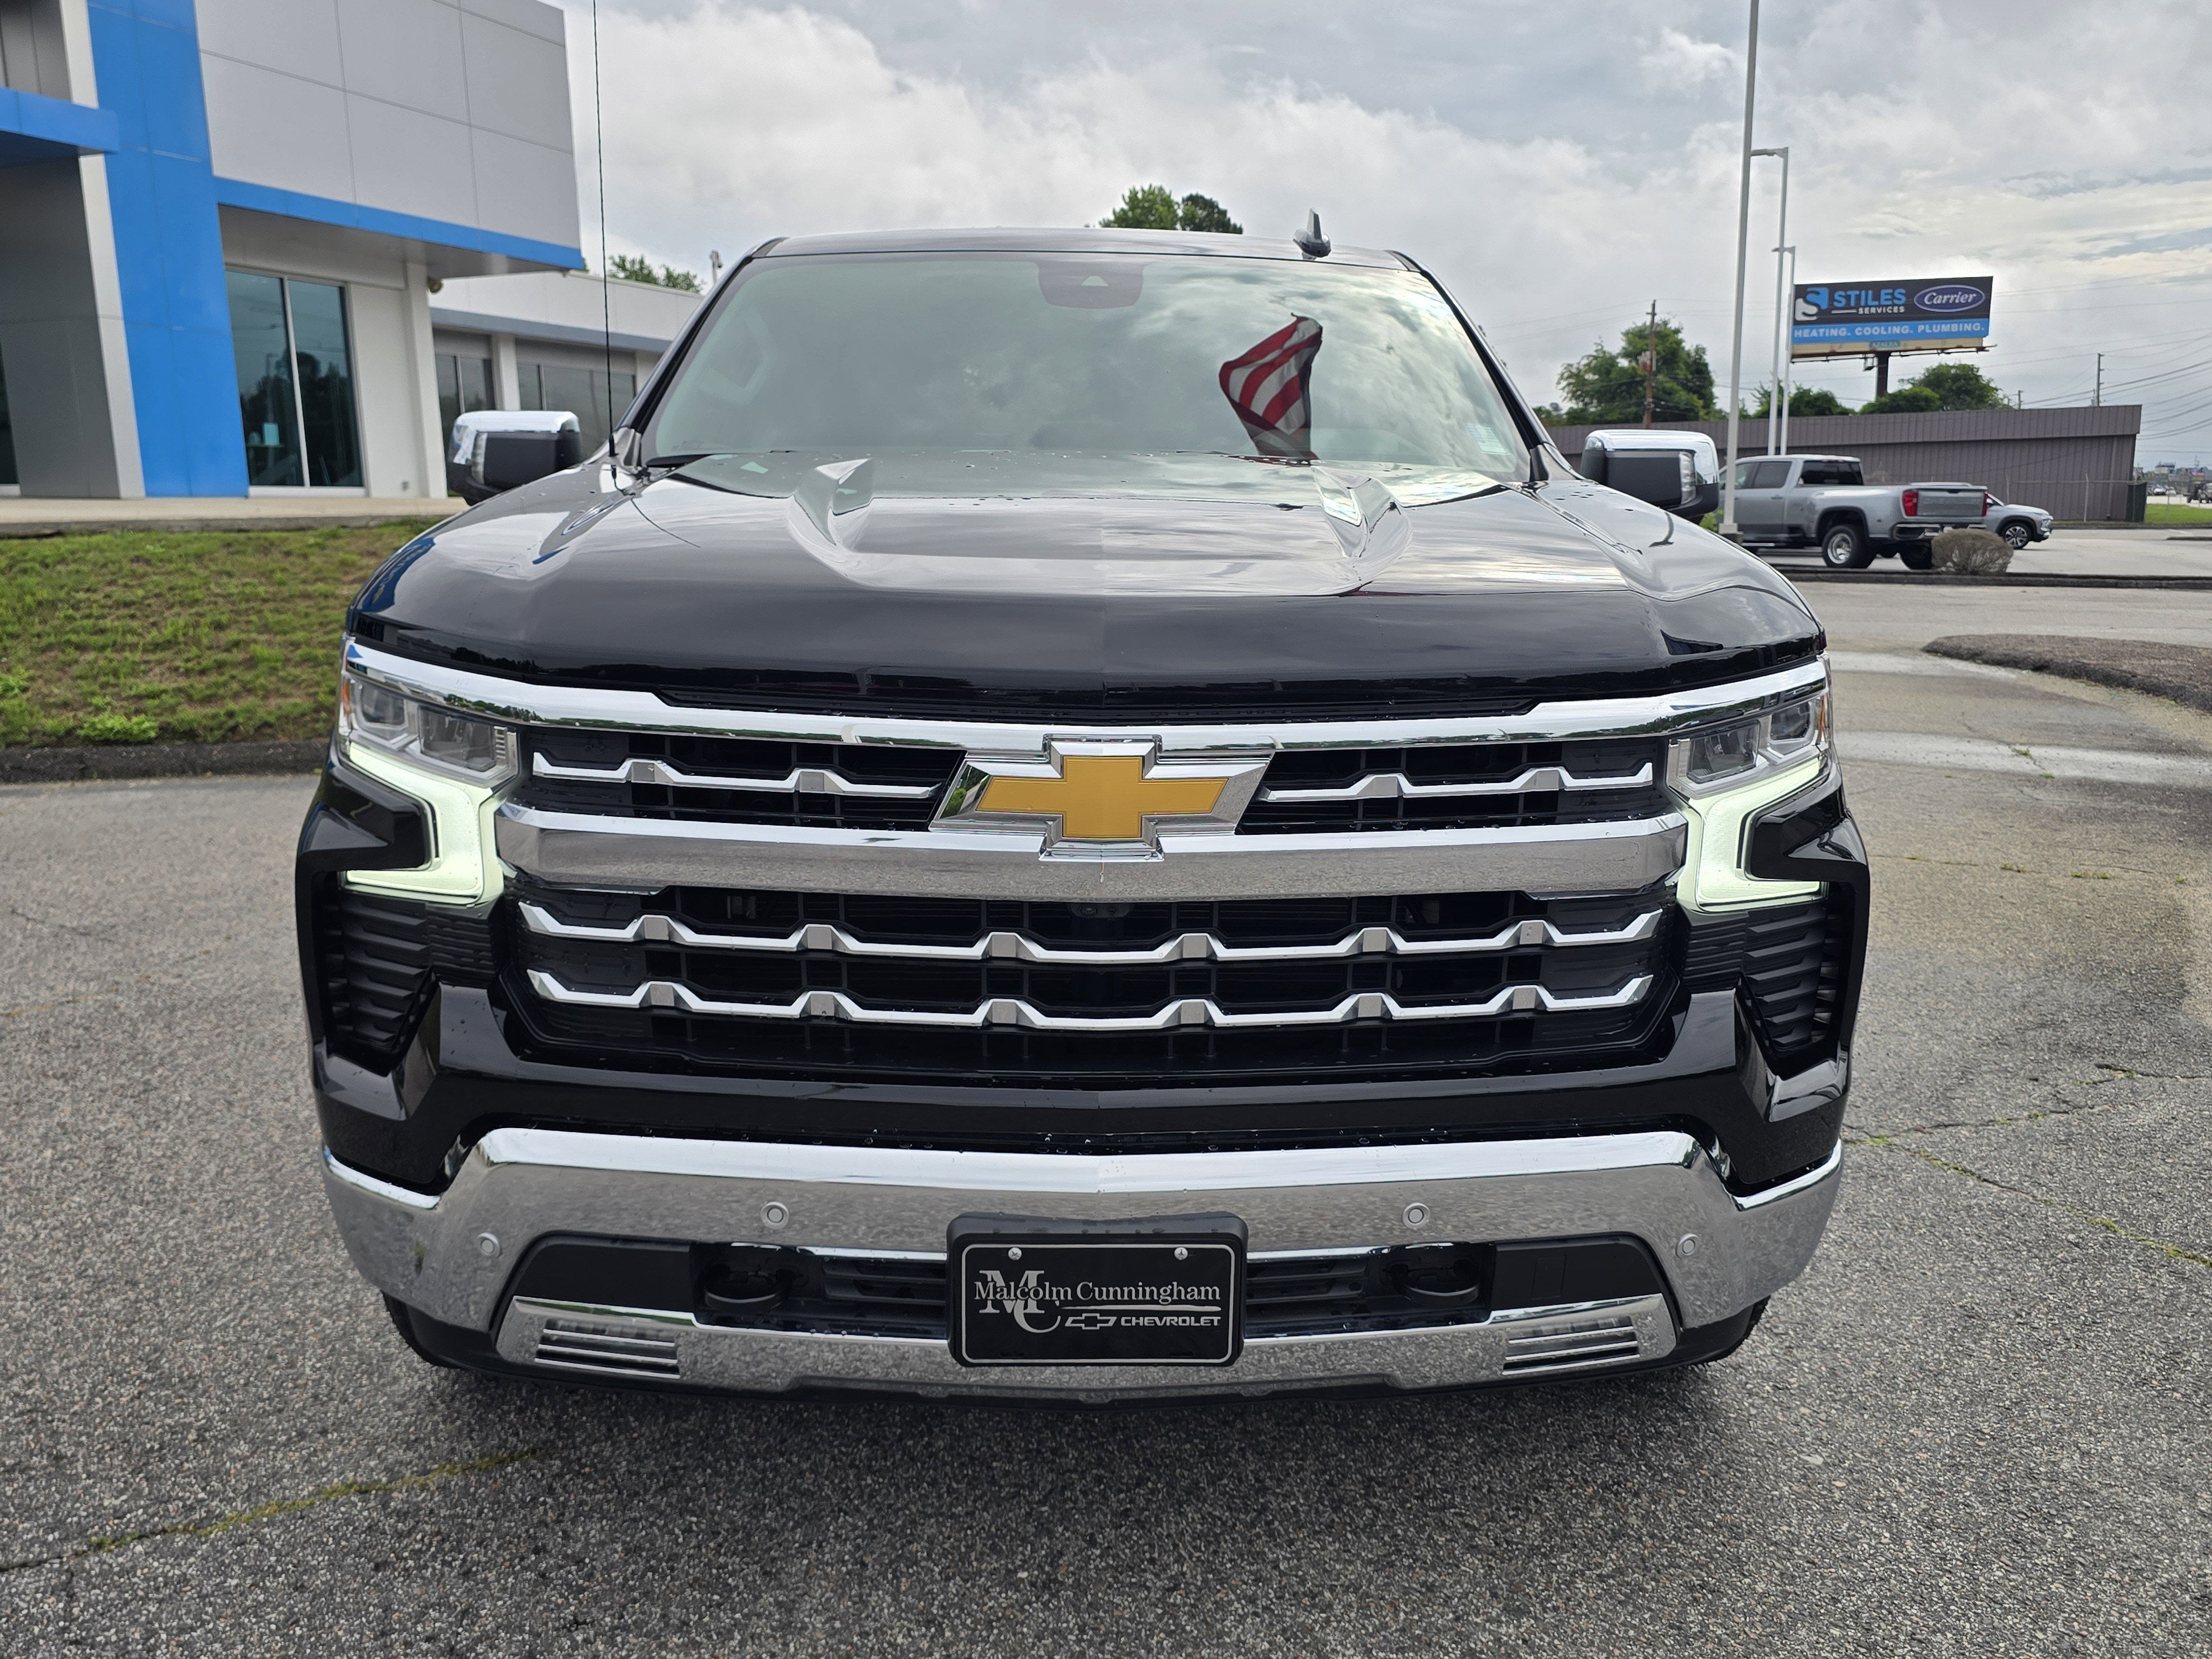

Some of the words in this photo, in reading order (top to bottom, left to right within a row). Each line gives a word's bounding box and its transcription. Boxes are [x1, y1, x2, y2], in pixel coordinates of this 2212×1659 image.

[1833, 289, 1906, 307] STILES
[1924, 291, 1976, 305] Carrier
[1858, 306, 1905, 315] SERVICES
[1794, 327, 1851, 338] HEATING.
[1855, 325, 1913, 336] COOLING.
[1918, 322, 1985, 333] PLUMBING.
[974, 1281, 1073, 1300] Malcolm
[1076, 1281, 1221, 1305] Cunningham
[1120, 1316, 1222, 1327] CHEVROLET
